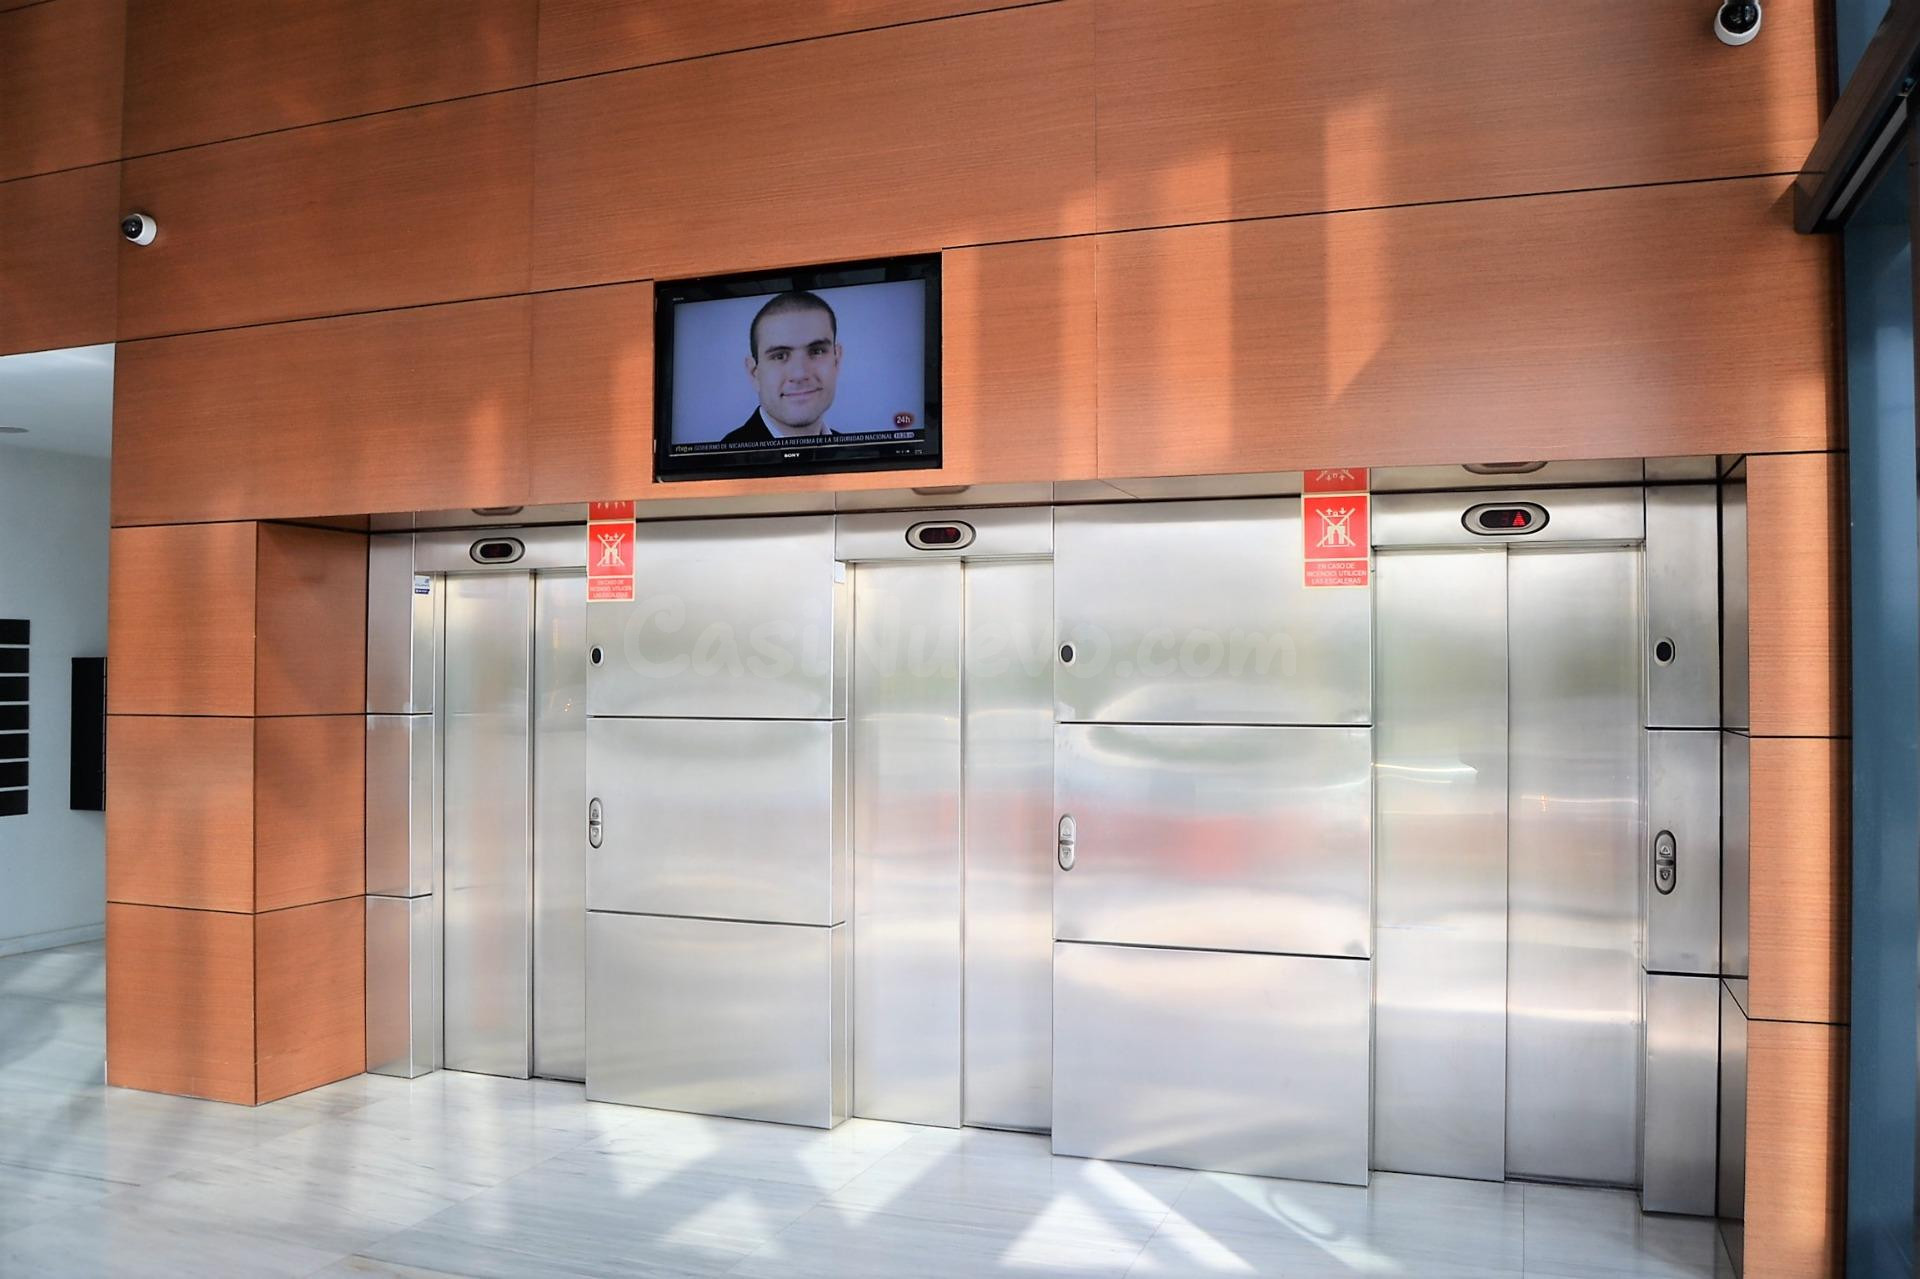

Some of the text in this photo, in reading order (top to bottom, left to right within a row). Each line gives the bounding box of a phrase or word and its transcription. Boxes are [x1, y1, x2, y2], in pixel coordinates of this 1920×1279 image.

[896, 416, 911, 424] 24h
[728, 441, 759, 449] NICARAGUA
[864, 433, 892, 441] NACIONAL
